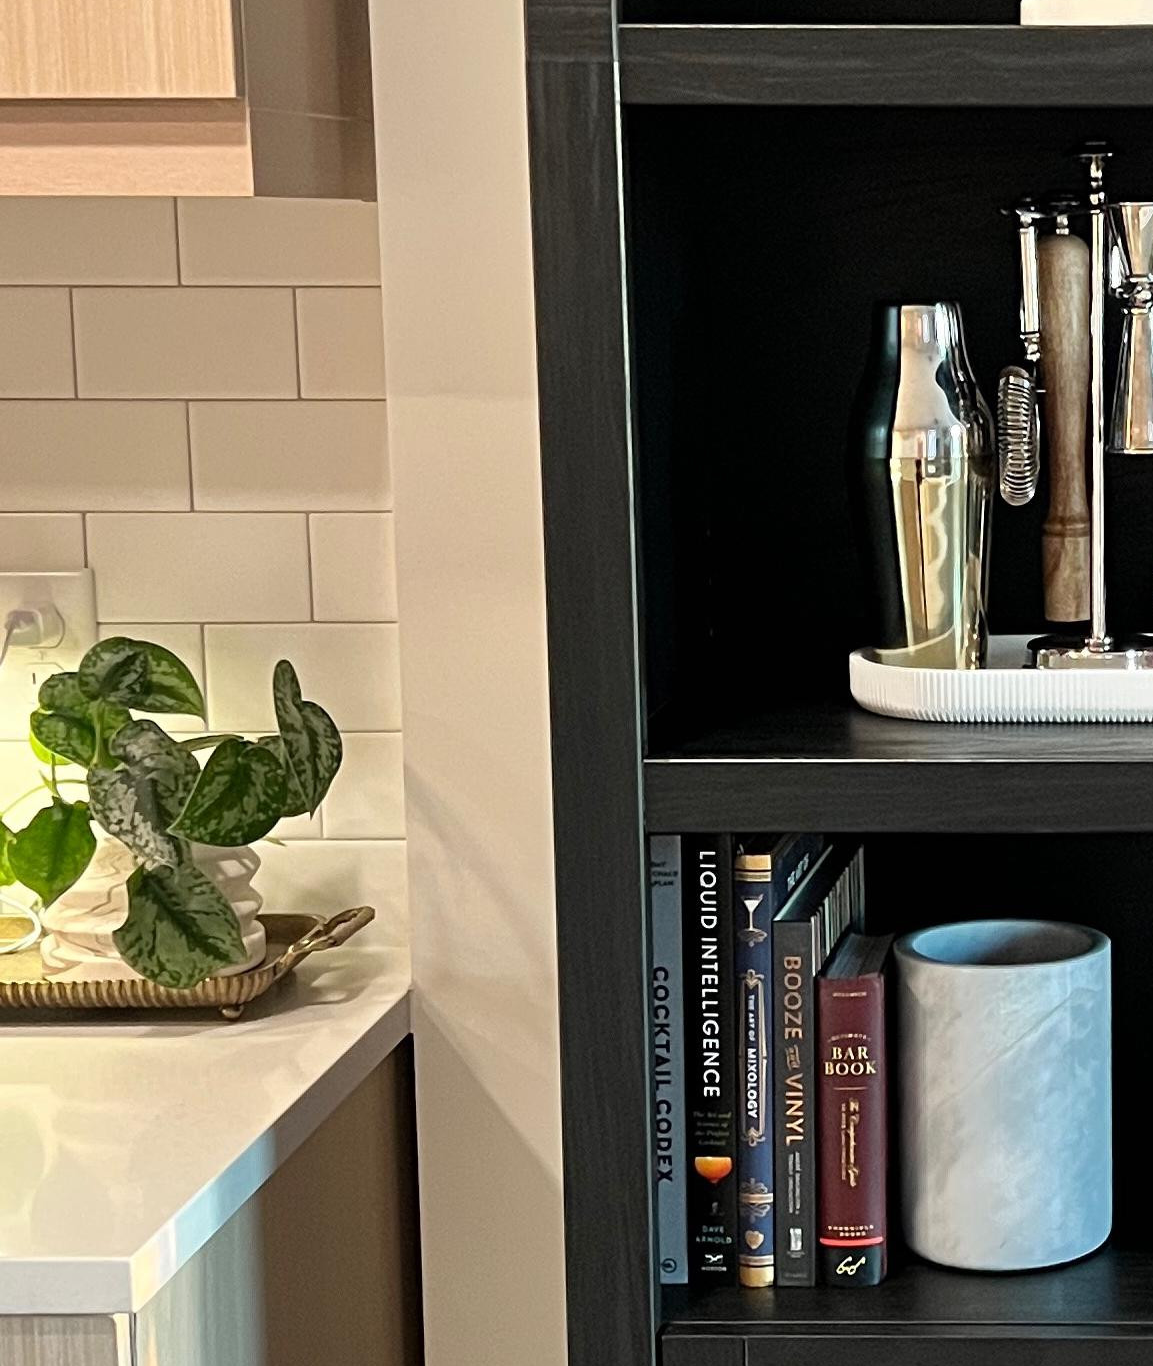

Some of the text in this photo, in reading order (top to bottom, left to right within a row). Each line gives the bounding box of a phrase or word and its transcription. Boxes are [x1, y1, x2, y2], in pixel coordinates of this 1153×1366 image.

[699, 851, 718, 930] LIQUID
[701, 937, 721, 1098] INTELLIGENCE
[748, 1012, 756, 1029] ART
[783, 956, 803, 1040] BOOZE
[653, 966, 673, 1183] COCKTAIL CODEX
[747, 1047, 758, 1119] MIXOLOGY
[824, 1060, 877, 1076] BOOK
[831, 1046, 869, 1060] BAR
[785, 1072, 805, 1147] VINYL
[695, 1236, 733, 1245] ARNOLD
[702, 1225, 725, 1234] DAVE
